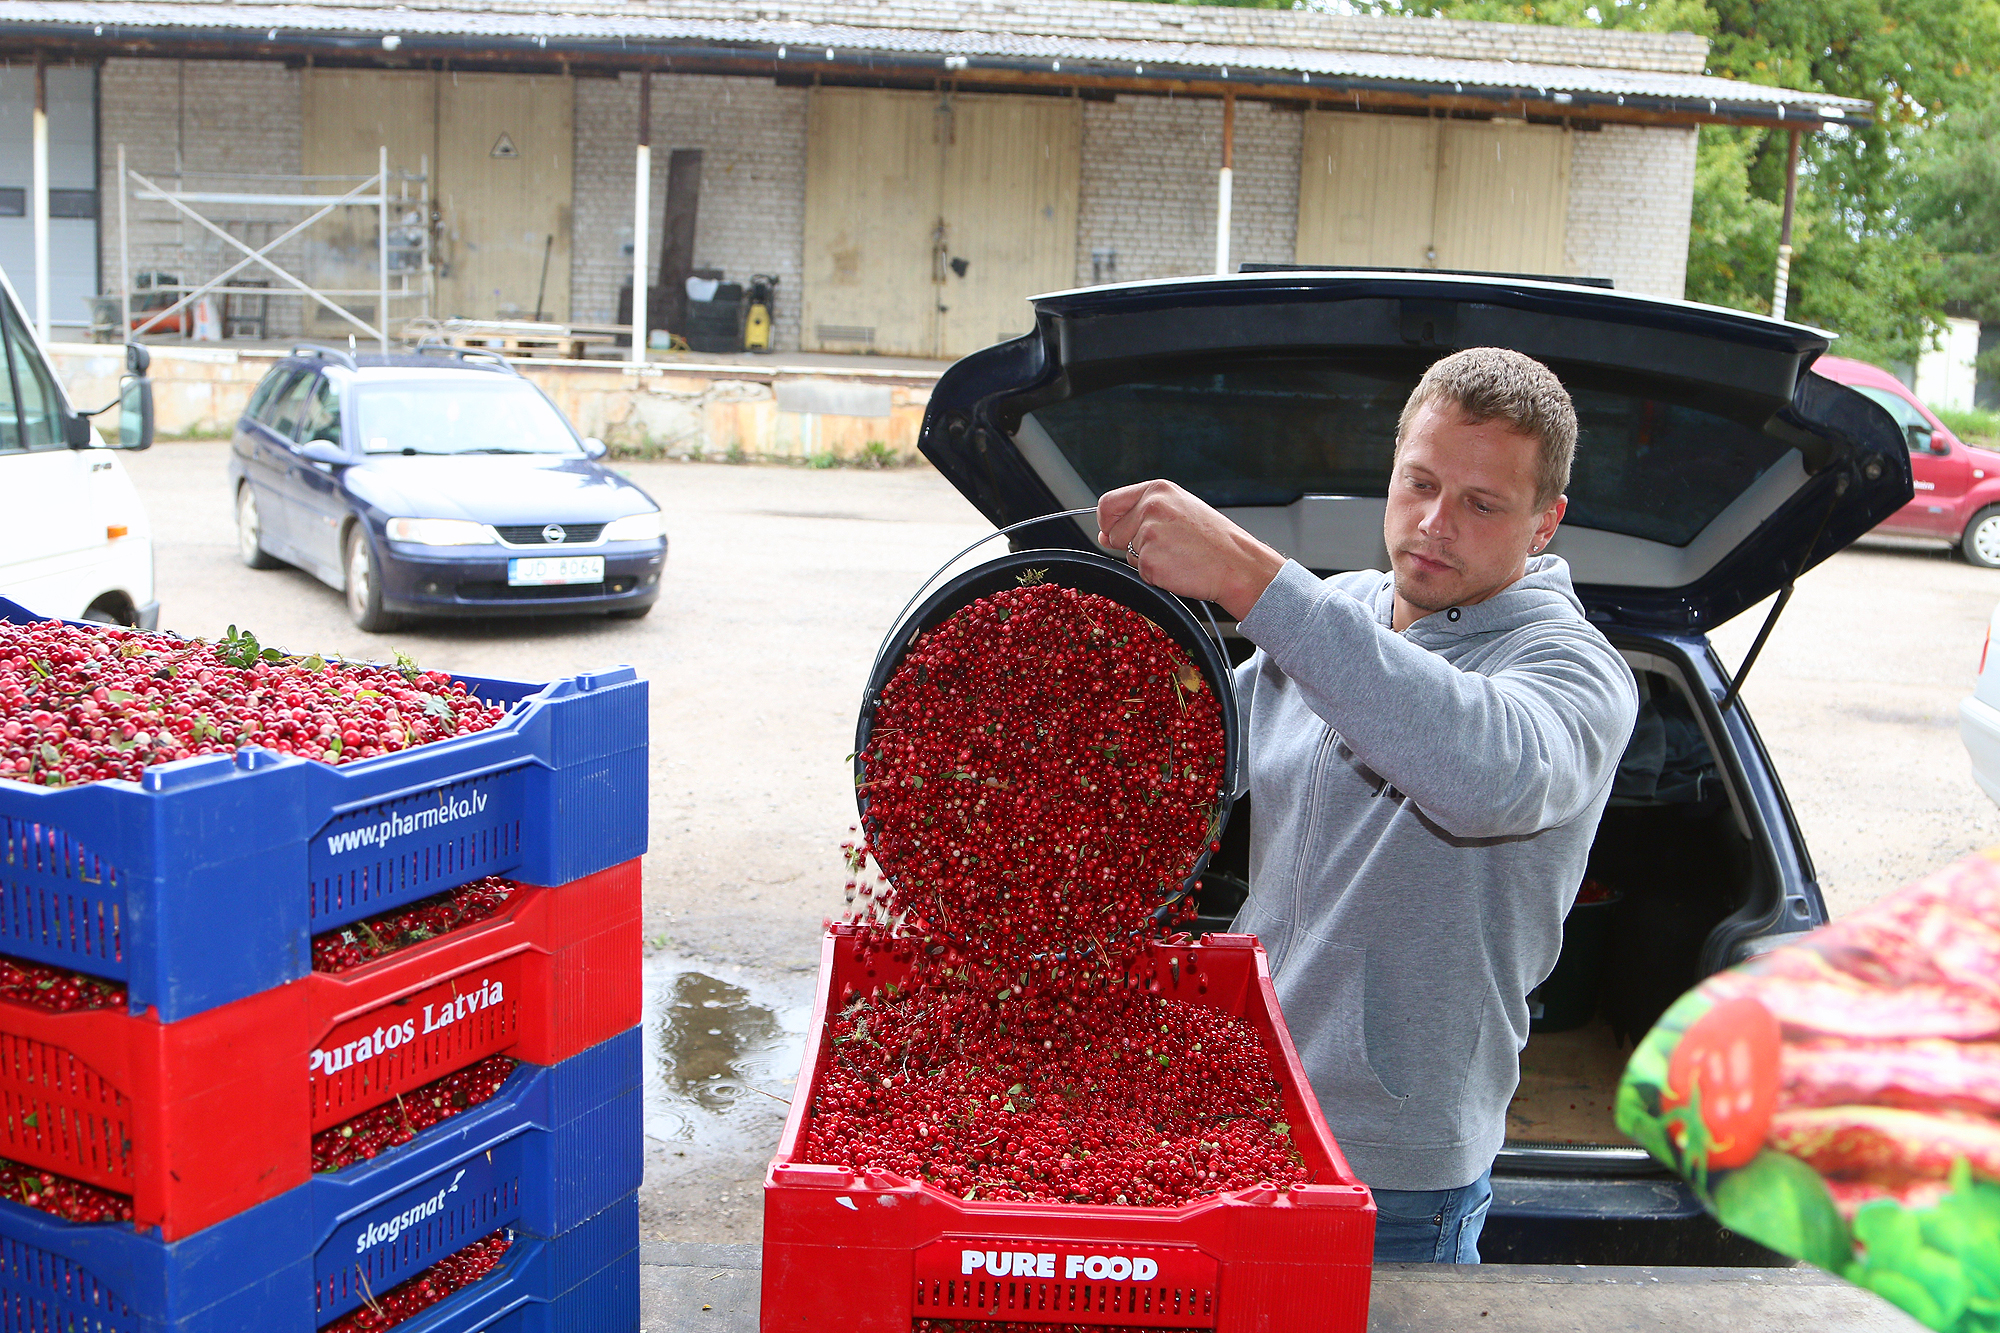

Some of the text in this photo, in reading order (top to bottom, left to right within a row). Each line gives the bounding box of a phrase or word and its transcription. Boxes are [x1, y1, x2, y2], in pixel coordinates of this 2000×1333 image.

[328, 789, 487, 856] www.pharmeko.lv
[309, 979, 503, 1075] Puratos Latvia
[356, 1189, 446, 1254] skogsmat
[961, 1250, 1158, 1281] PURE FOOD
